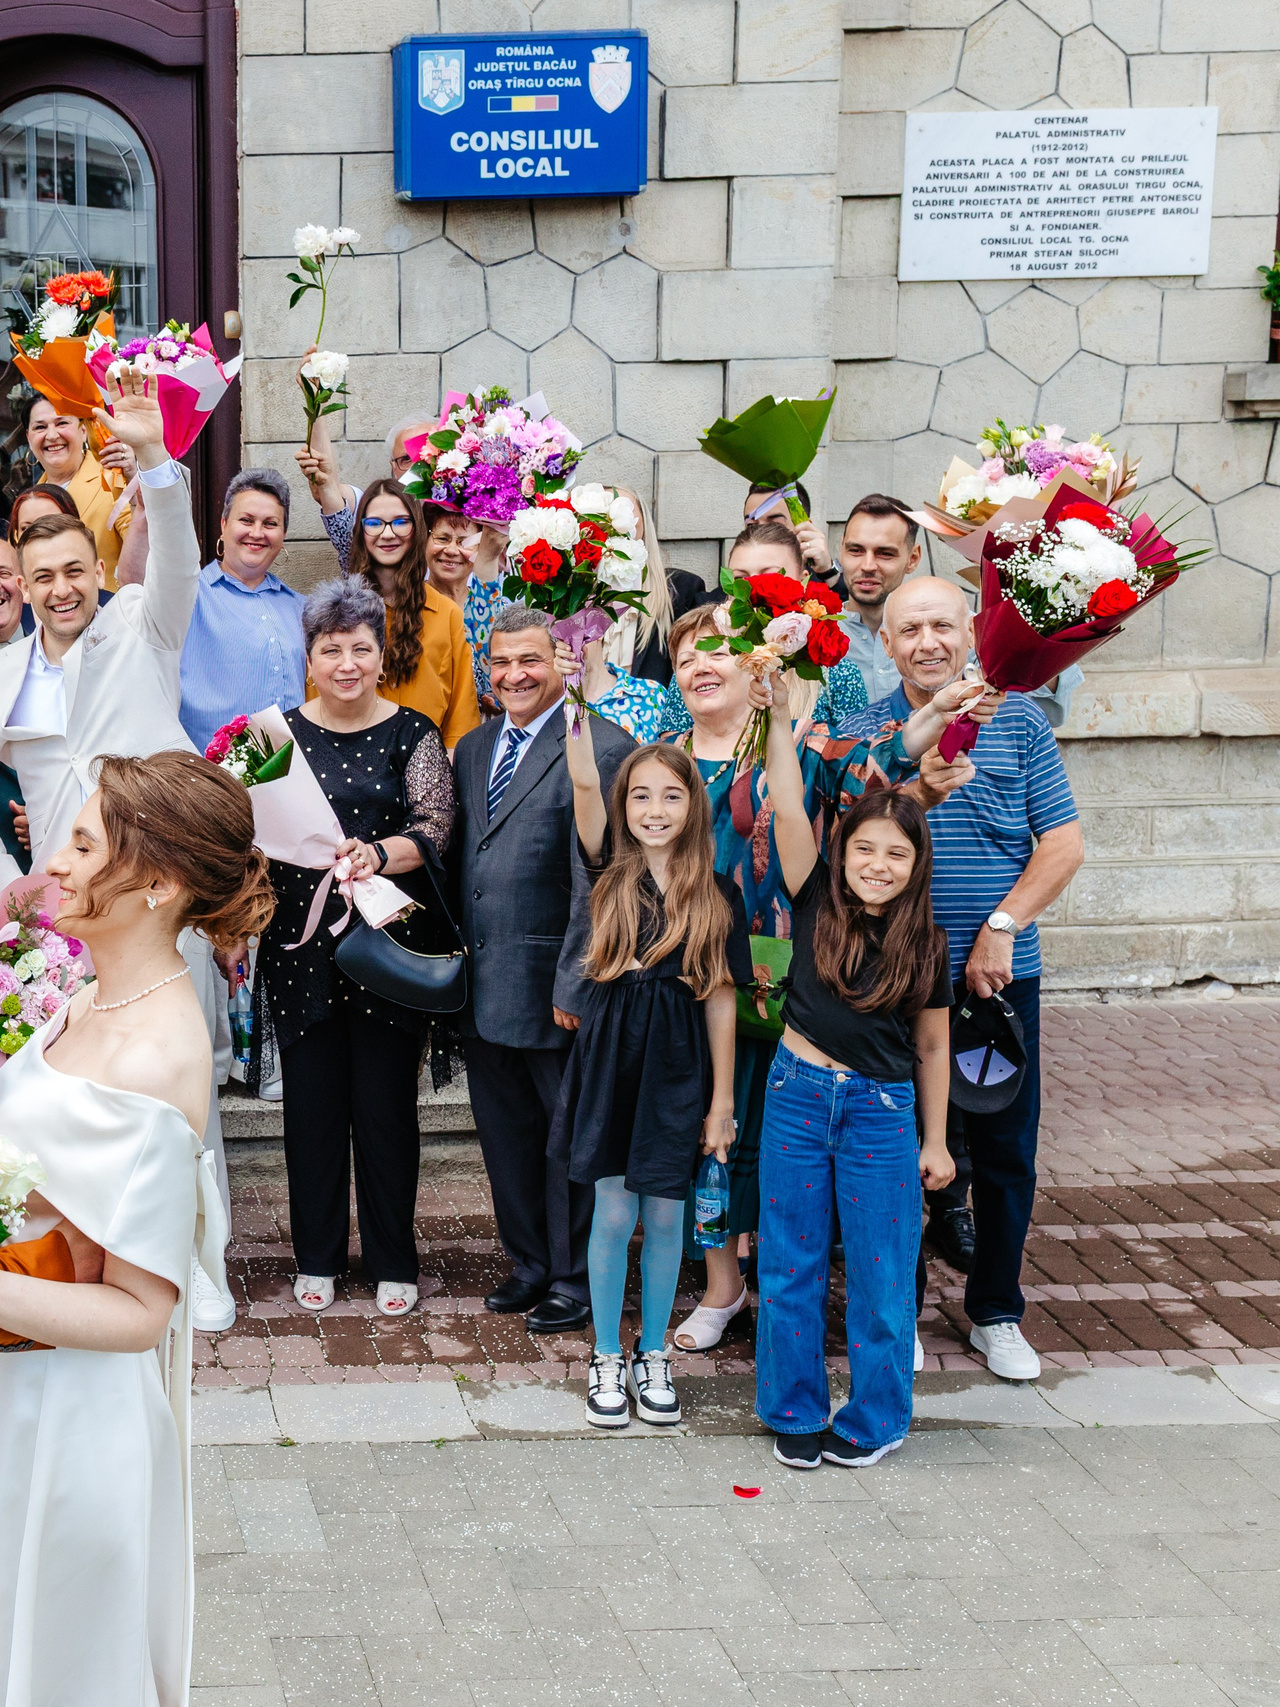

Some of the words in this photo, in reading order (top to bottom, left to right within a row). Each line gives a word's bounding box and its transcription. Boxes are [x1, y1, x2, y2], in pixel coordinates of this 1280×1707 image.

[496, 44, 555, 56] ROMÂNIA
[533, 59, 577, 70] BACĂU
[504, 77, 544, 88] TÎRGU
[546, 78, 582, 87] OCNA
[1034, 116, 1089, 125] CENTENAR
[995, 130, 1041, 139] PALATUL
[1046, 129, 1126, 138] ADMINISTRATIV
[450, 129, 599, 152] CONSILIUL
[1031, 142, 1089, 153] (1912-2012)
[929, 158, 976, 167] ACEASTA
[981, 158, 1015, 166] PLACA
[1020, 157, 1028, 166] A
[1033, 156, 1060, 165] FOST
[1065, 156, 1115, 164] MONTATA
[1120, 155, 1135, 164] CU
[1141, 154, 1189, 163] PRILEJUL
[480, 157, 570, 178] LOCAL
[925, 171, 990, 181] ANIVERSARII
[995, 171, 1003, 179] A
[1009, 170, 1027, 179] 100
[1032, 170, 1046, 179] DE
[1051, 170, 1070, 178] ANI
[1075, 169, 1089, 178] DE
[1094, 169, 1108, 177] LA
[1113, 167, 1185, 177] CONSTRUIREA
[912, 185, 968, 194] PALATULUI
[974, 184, 1053, 193] ADMINISTRATIV
[1058, 183, 1072, 191] AL
[1077, 182, 1129, 191] ORASULUI
[1135, 181, 1166, 190] TIRGU
[911, 198, 955, 208] CLADIRE
[958, 197, 1023, 207] PROIECTATA
[1026, 197, 1040, 205] DE
[1045, 196, 1096, 205] ARHITECT
[1102, 195, 1134, 204] PETRE
[1140, 193, 1202, 203] ANTONESCU
[913, 212, 924, 221] SI
[929, 211, 994, 220] CONSTRUITA
[1000, 211, 1013, 219] DE
[1019, 209, 1100, 219] ANTREPRENORII
[1106, 207, 1156, 217] GIUSEPPE
[1162, 207, 1199, 216] BAROLI
[1009, 224, 1019, 232] SI
[1025, 224, 1035, 232] A.
[980, 237, 1034, 246] CONSILIUL
[1040, 236, 1073, 245] LOCAL
[1078, 235, 1095, 244] TG.
[1101, 235, 1129, 244] OCNA
[989, 250, 1028, 259] PRIMAR
[1034, 249, 1073, 258] STEFAN
[1009, 263, 1022, 272] 18
[1026, 262, 1069, 271] AUGUST
[1074, 261, 1098, 270] 2012
